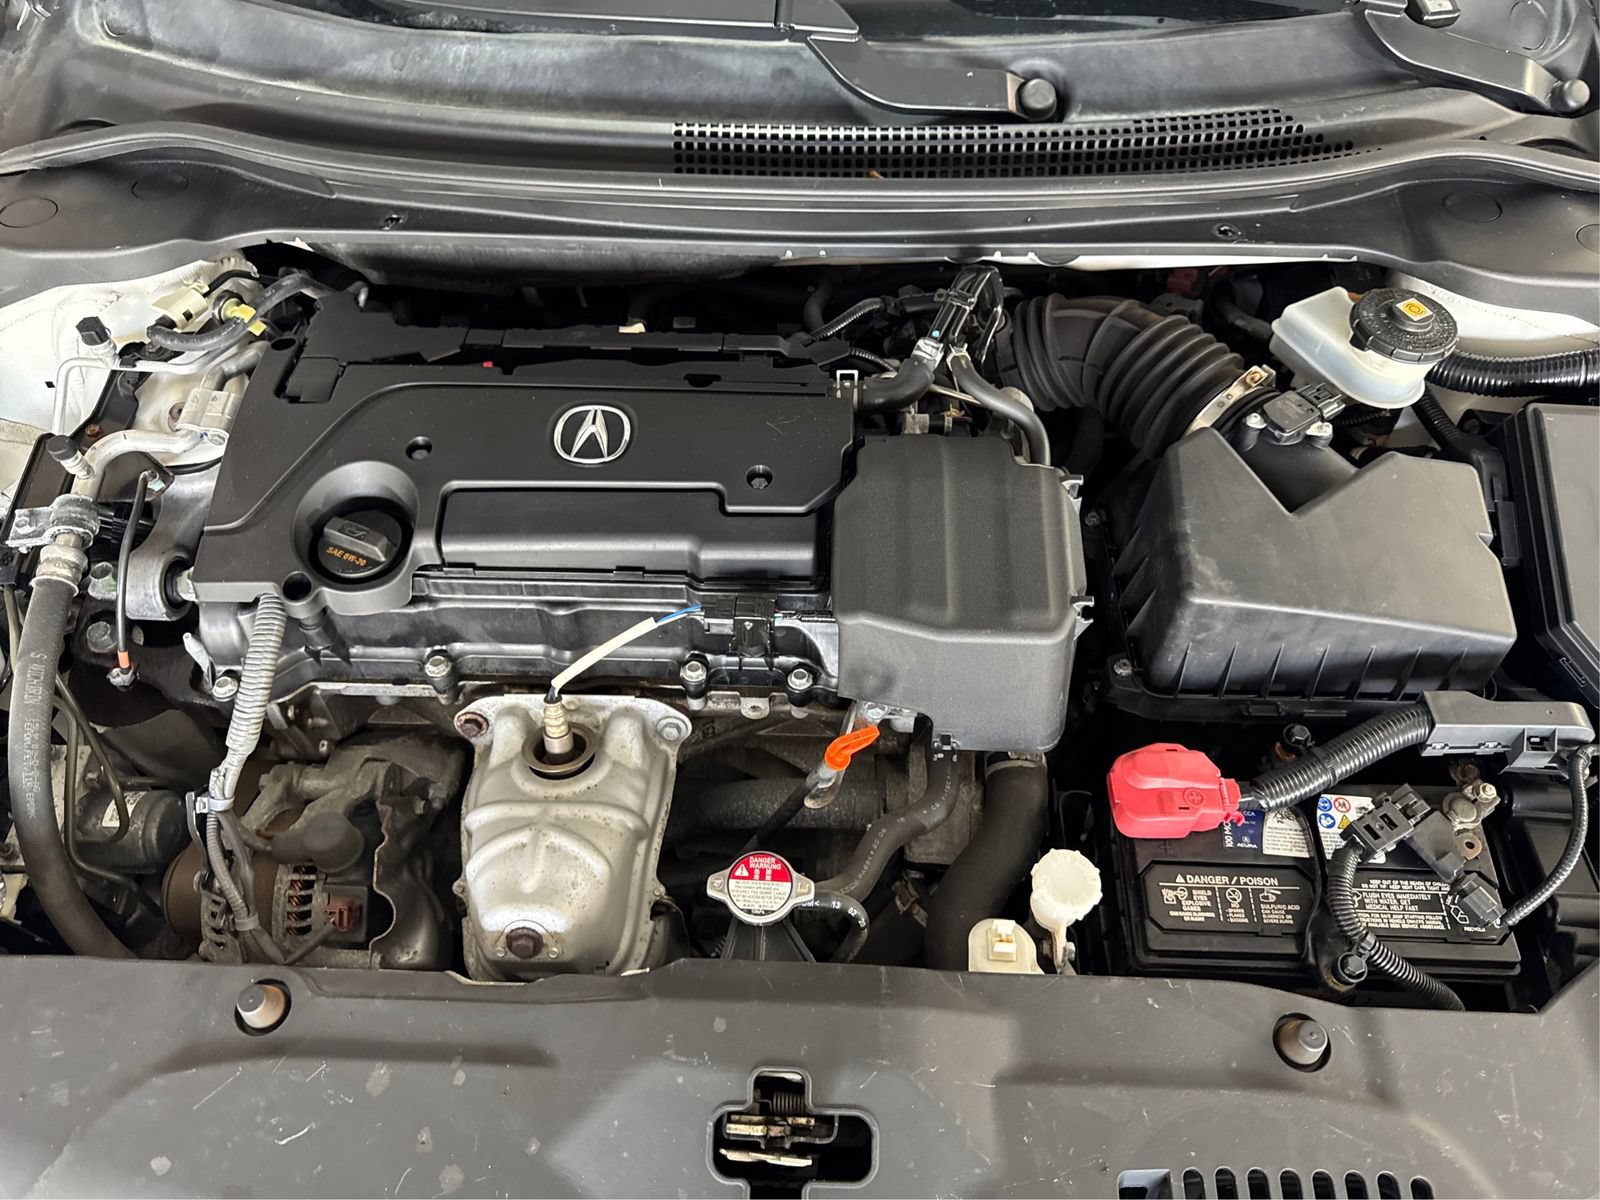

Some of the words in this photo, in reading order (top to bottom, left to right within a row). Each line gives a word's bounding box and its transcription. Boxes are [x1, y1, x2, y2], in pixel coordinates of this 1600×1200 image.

[326, 546, 344, 558] SAE
[343, 552, 367, 566] 0W-20
[1186, 874, 1229, 885] DANGER
[1240, 876, 1278, 886] POISON
[831, 900, 842, 909] 13
[848, 907, 857, 917] 02
